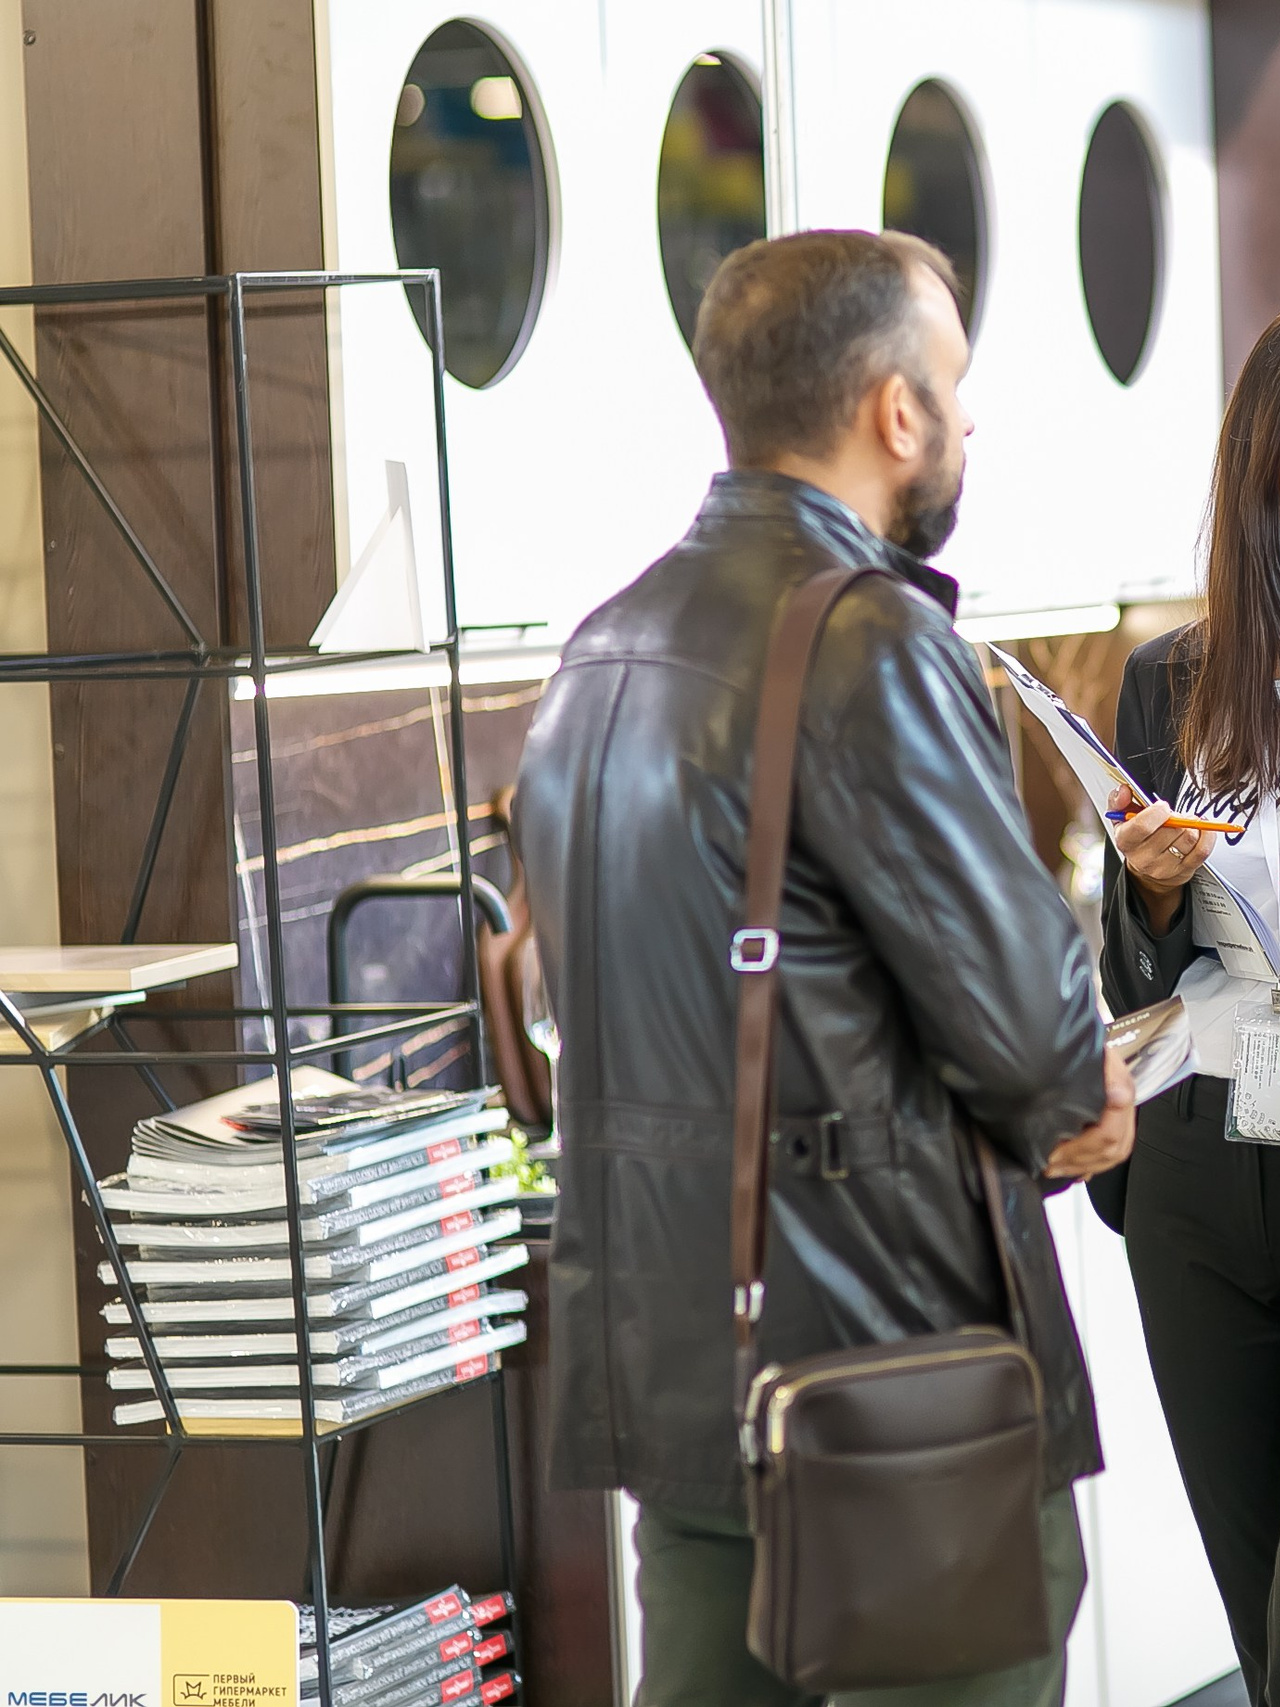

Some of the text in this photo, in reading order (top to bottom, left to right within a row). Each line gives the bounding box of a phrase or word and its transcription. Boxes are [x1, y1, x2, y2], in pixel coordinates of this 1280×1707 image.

[213, 1673, 256, 1684] ПЕРВЫЙ
[213, 1686, 287, 1697] ГИПЕРМАРКЕТ
[8, 1691, 147, 1707] МЕБЕЛИК
[213, 1698, 256, 1707] МЕБЕЛИ
